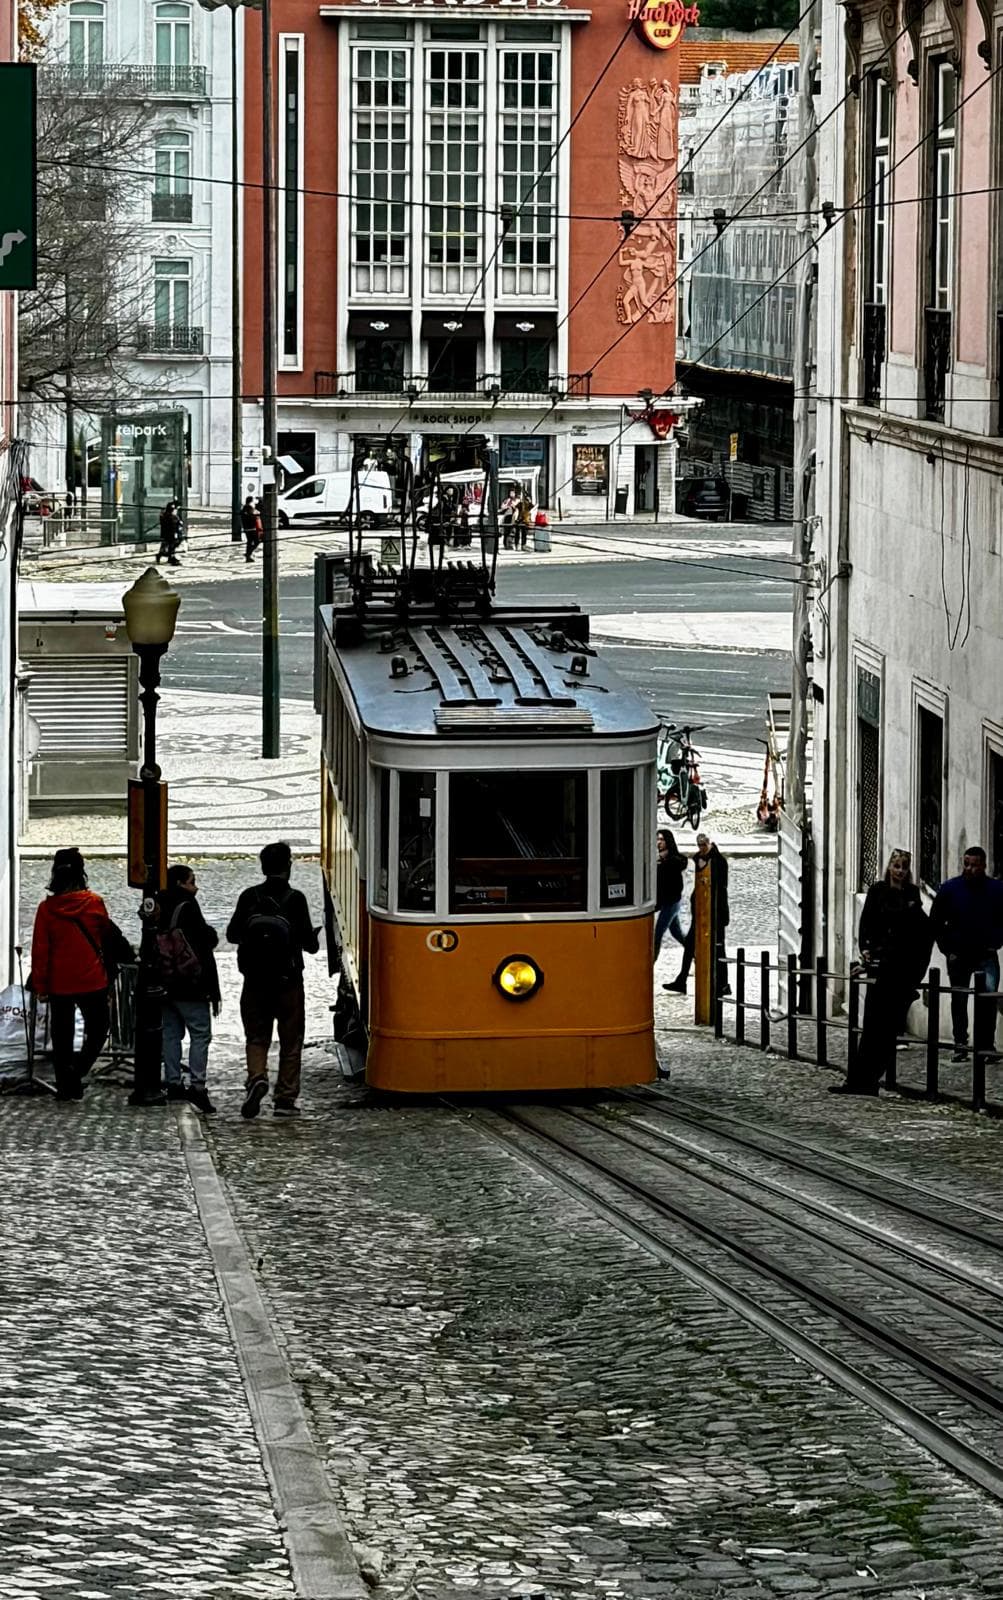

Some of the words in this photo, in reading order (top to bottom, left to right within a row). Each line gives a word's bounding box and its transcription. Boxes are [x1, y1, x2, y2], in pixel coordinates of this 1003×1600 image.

[628, 0, 665, 21] Hard
[667, 2, 700, 27] Rock
[422, 415, 449, 424] ROCK
[453, 415, 481, 424] SHOP
